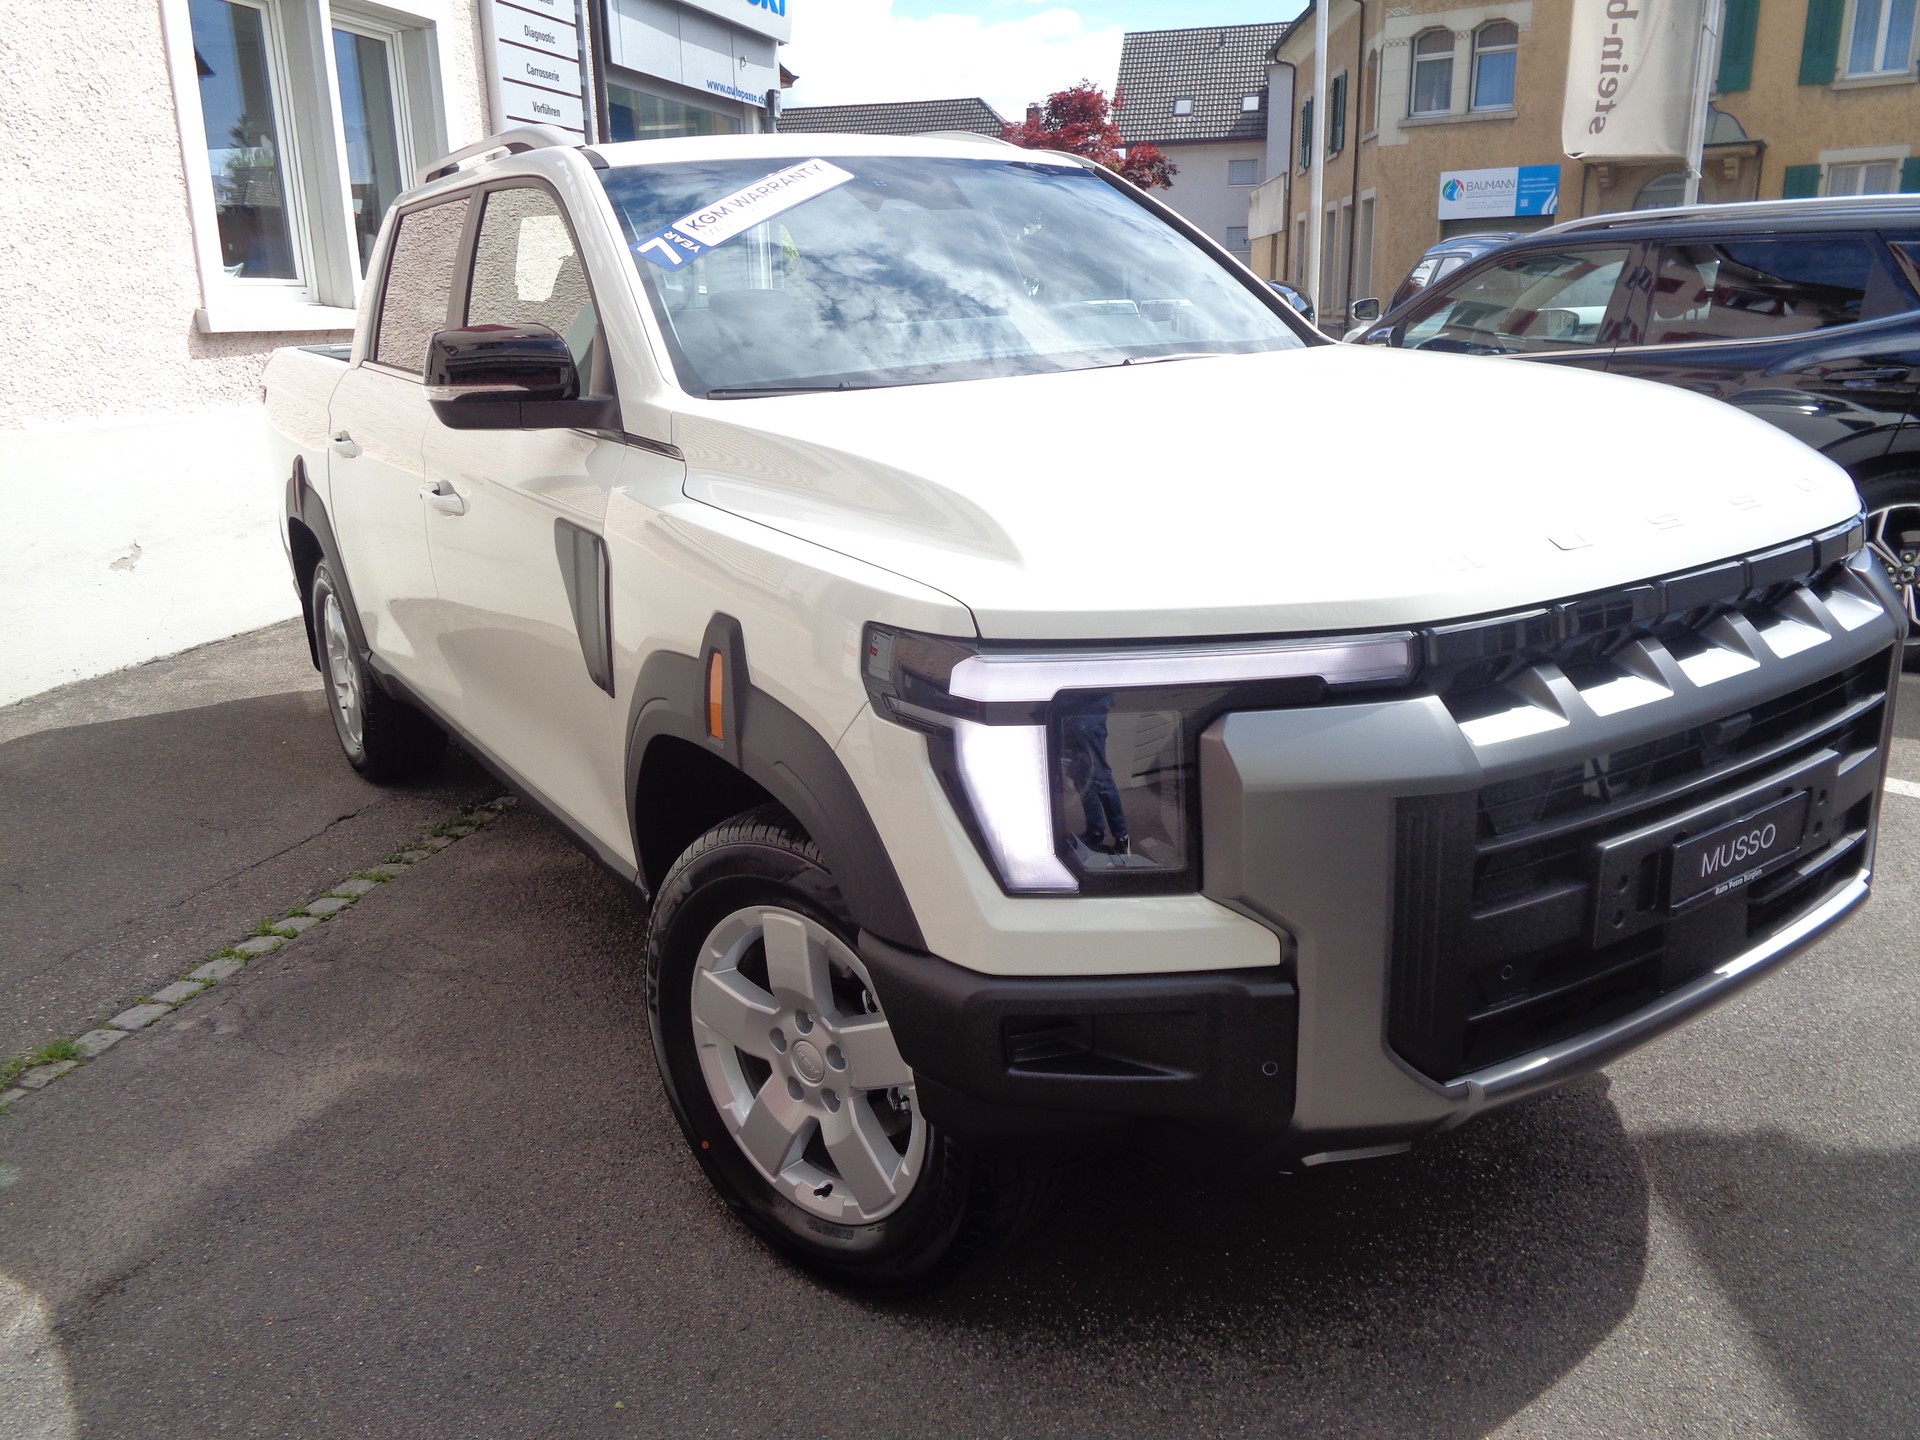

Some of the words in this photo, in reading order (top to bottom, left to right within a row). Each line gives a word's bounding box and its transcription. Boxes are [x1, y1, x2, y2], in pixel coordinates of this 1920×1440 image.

[524, 24, 556, 44] Diagnostic
[526, 63, 560, 82] Carrosserie
[532, 101, 561, 118] Vorführen
[1466, 179, 1516, 192] BAUMANN
[685, 206, 733, 231] KGM
[728, 163, 824, 210] WARRANTY
[636, 237, 683, 266] 7
[663, 230, 702, 254] YEAR
[1701, 823, 1776, 878] MUSSO
[1715, 884, 1728, 895] Auto
